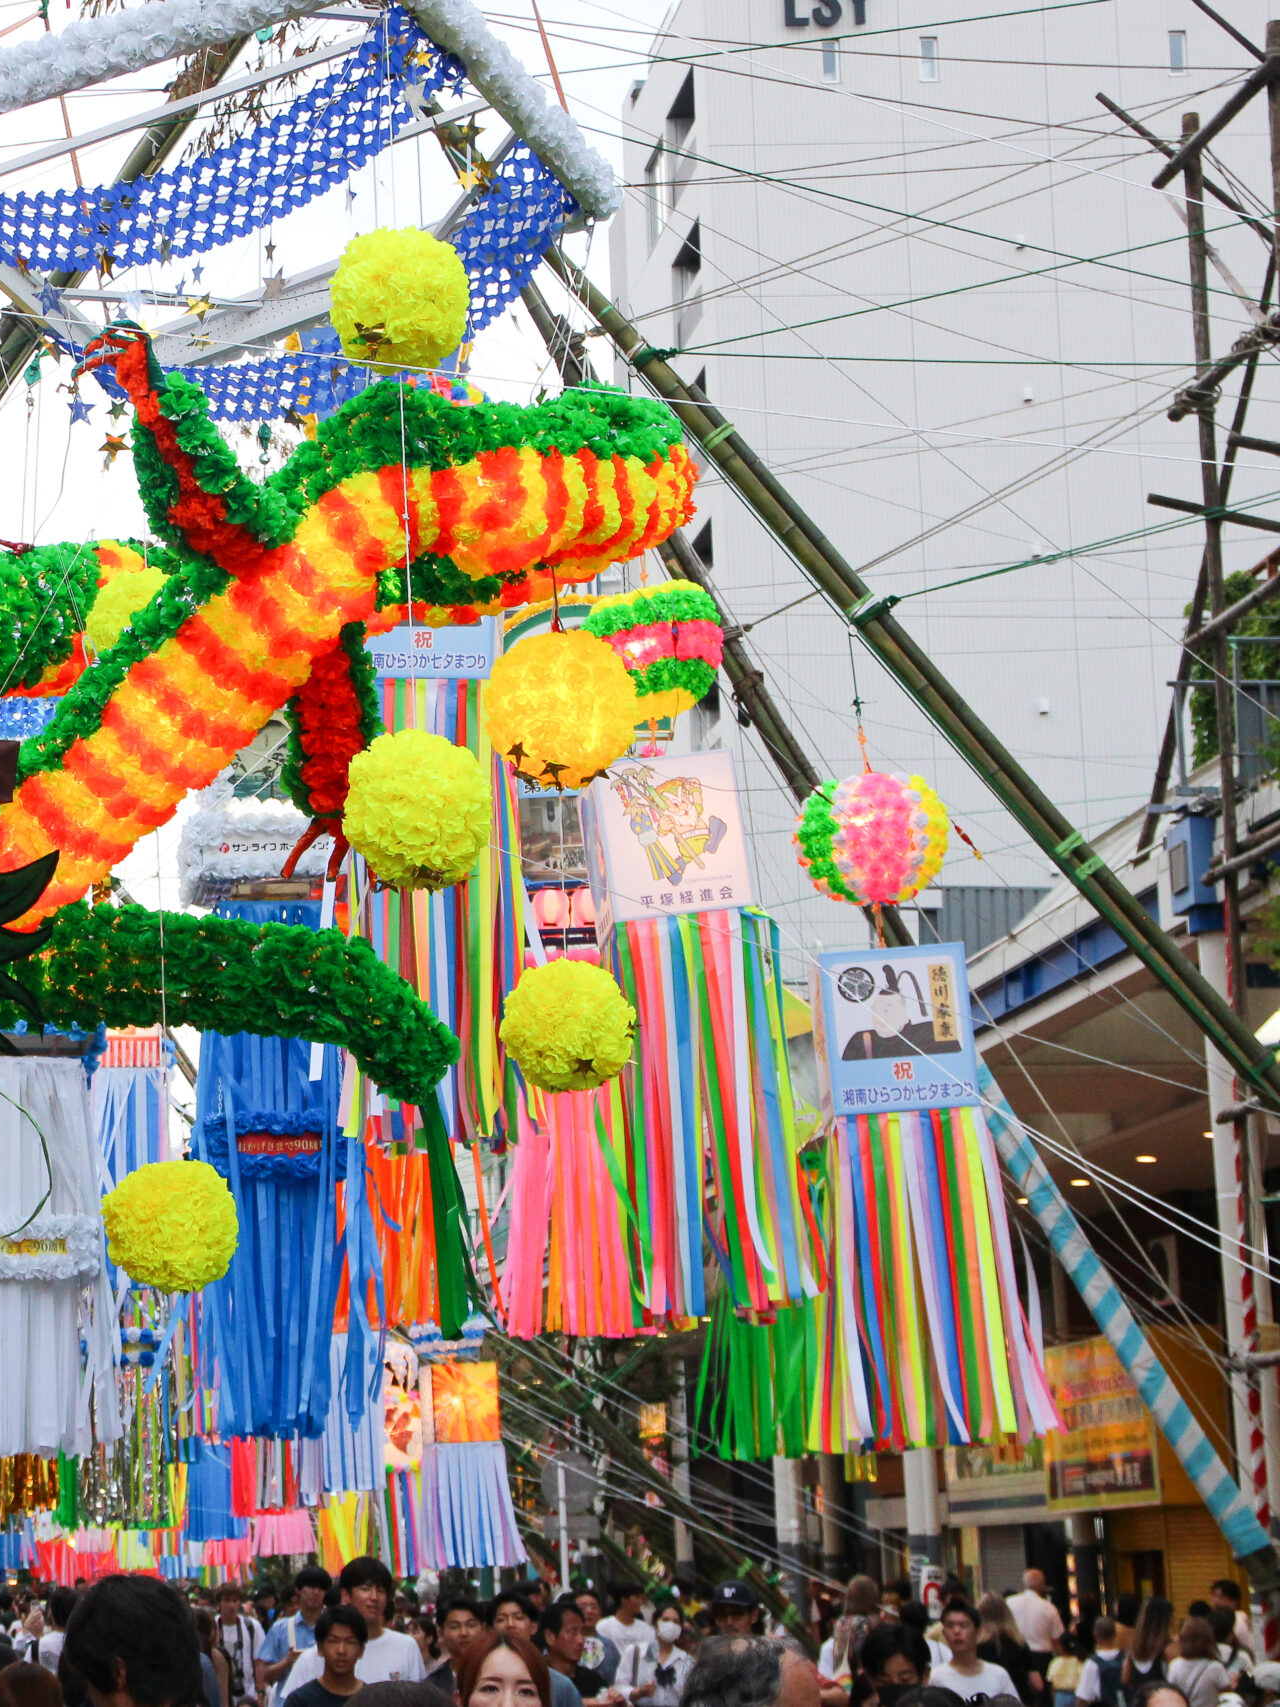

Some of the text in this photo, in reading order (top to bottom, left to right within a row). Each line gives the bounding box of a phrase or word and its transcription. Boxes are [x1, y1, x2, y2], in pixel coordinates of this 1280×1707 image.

[414, 631, 433, 649] 祝
[640, 886, 734, 908] 平塚経進会
[931, 965, 953, 1038] 徳川家康
[893, 1062, 914, 1081] 祝
[842, 1081, 974, 1106] 湘南ひらつか七夕まつり
[237, 1140, 323, 1152] おかげさまで90周
